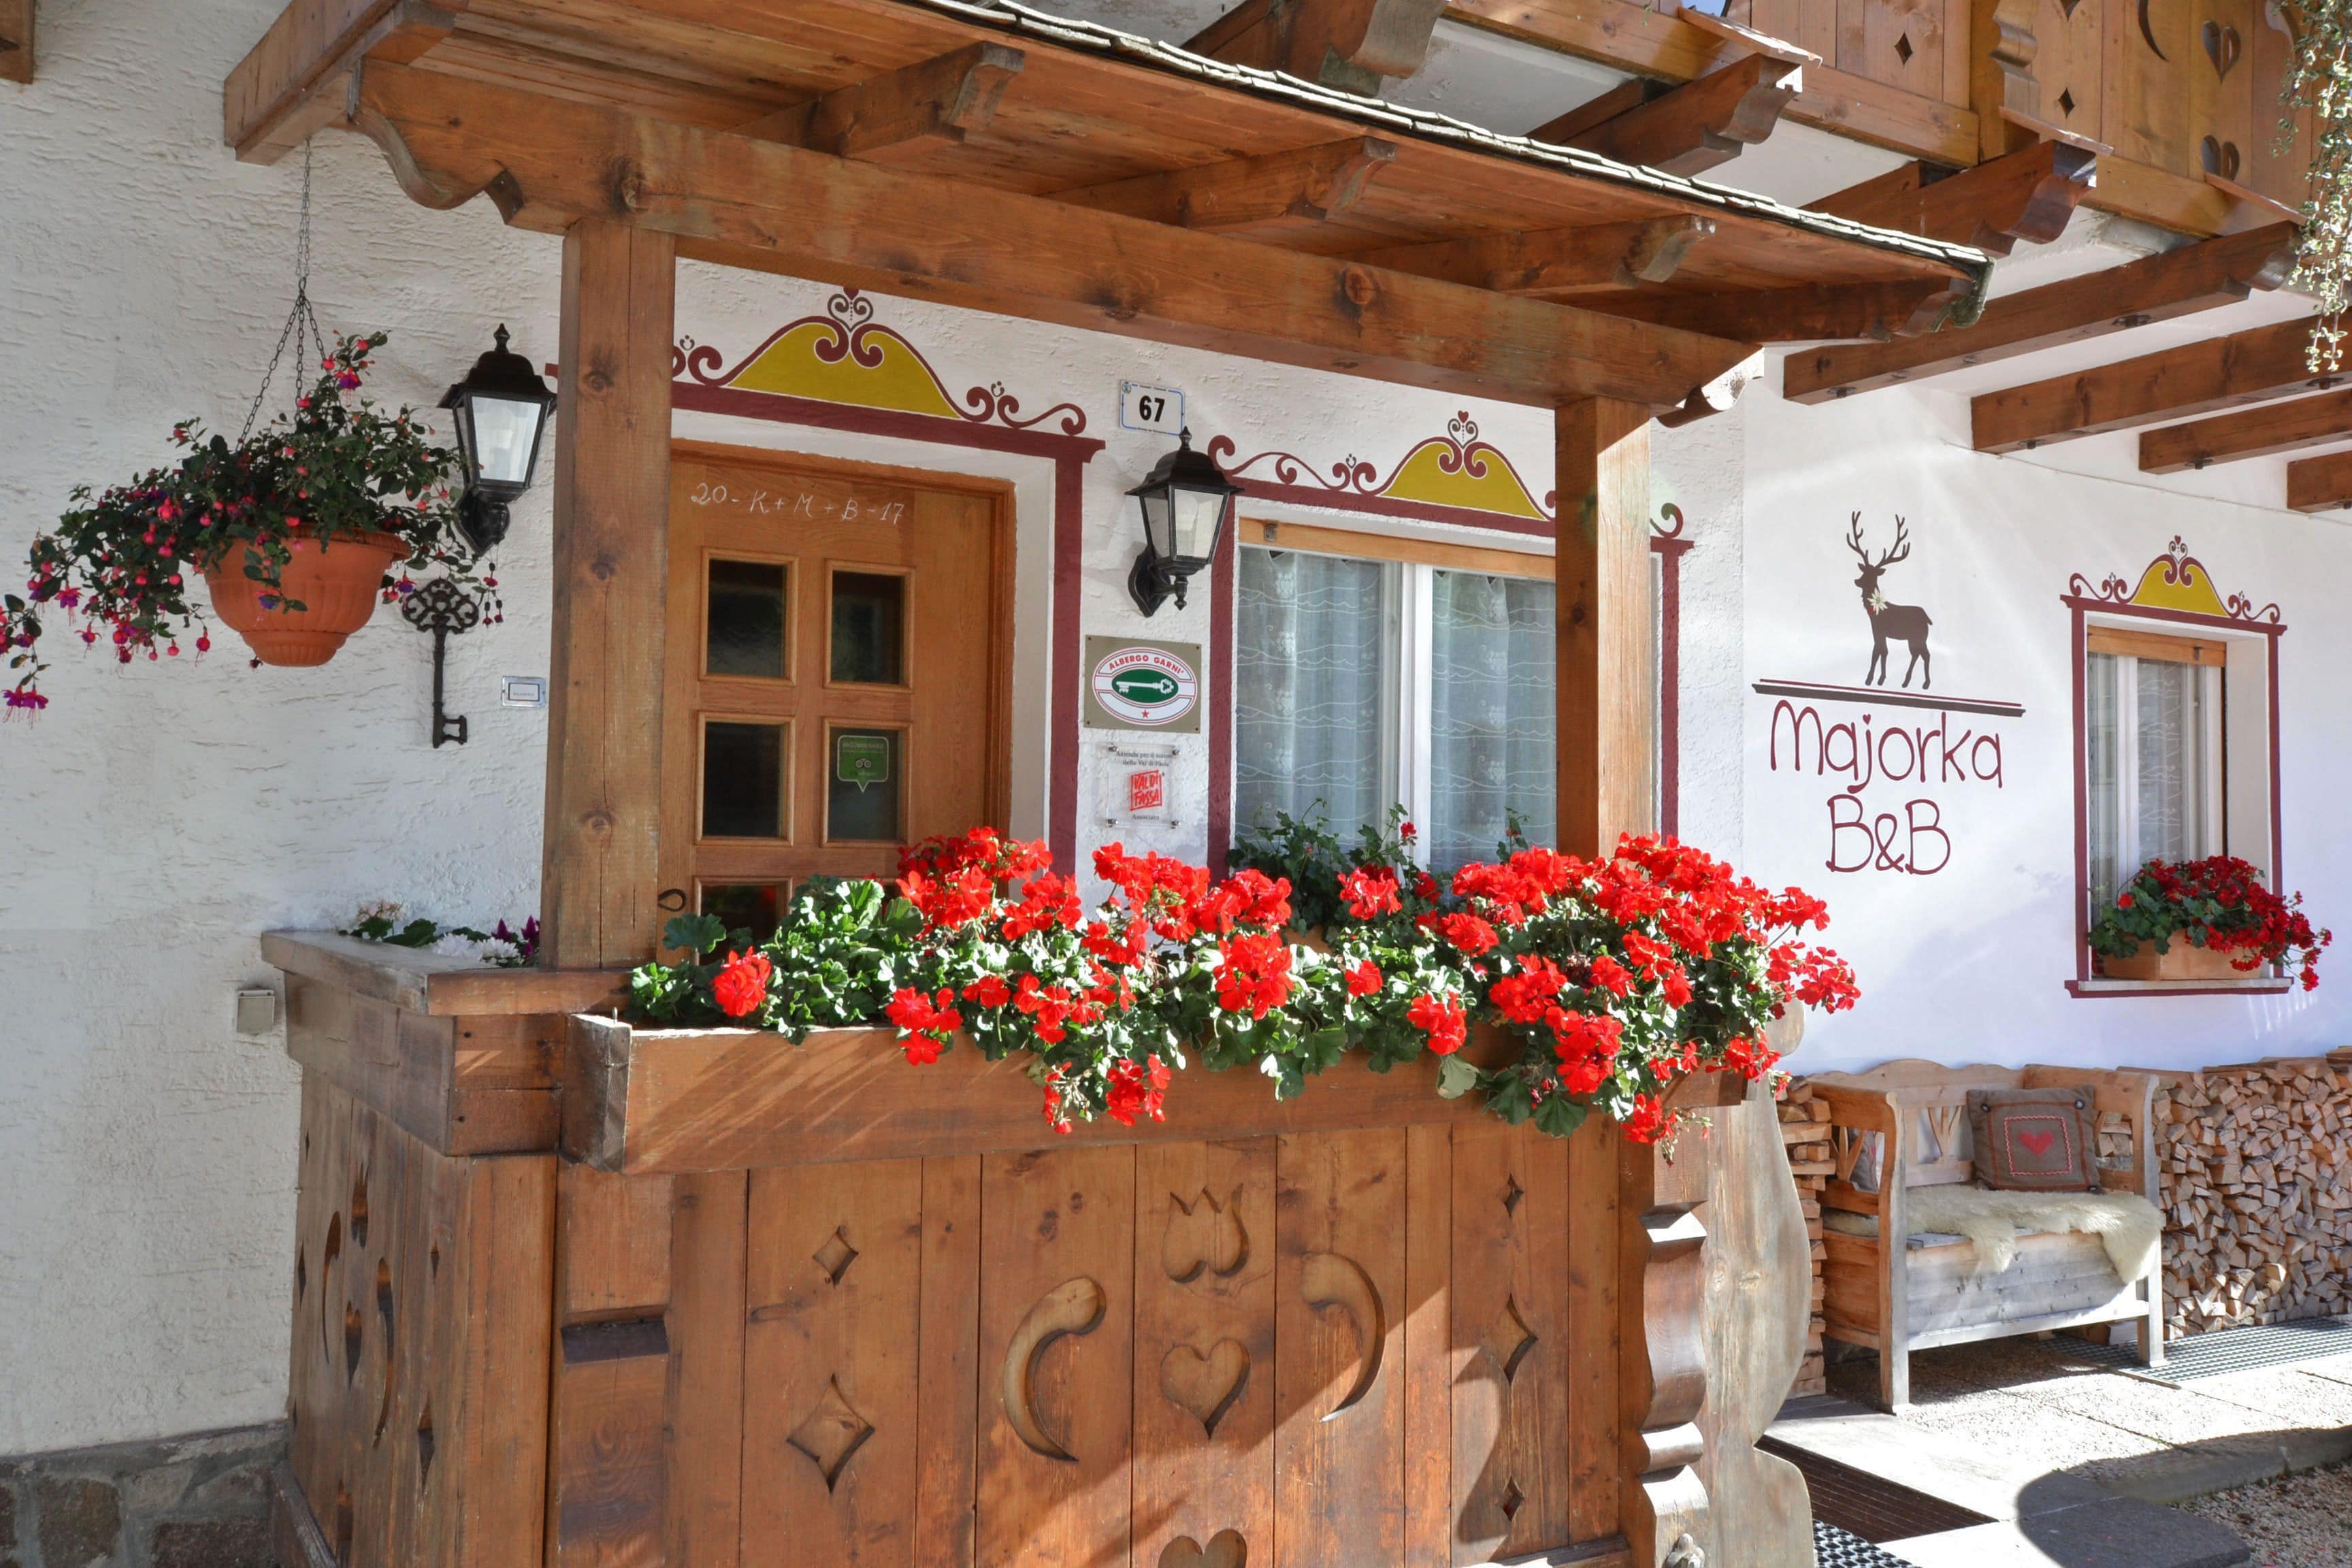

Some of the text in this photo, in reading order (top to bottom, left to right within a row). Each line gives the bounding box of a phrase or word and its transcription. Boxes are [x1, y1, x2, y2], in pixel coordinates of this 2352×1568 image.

[1139, 395, 1165, 423] 67
[1109, 654, 1149, 670] ALBERGO
[1769, 699, 2003, 794] Majorka
[1134, 774, 1158, 790] VAL DI
[1134, 788, 1160, 806] FASSA
[1825, 794, 1951, 875] B&B
